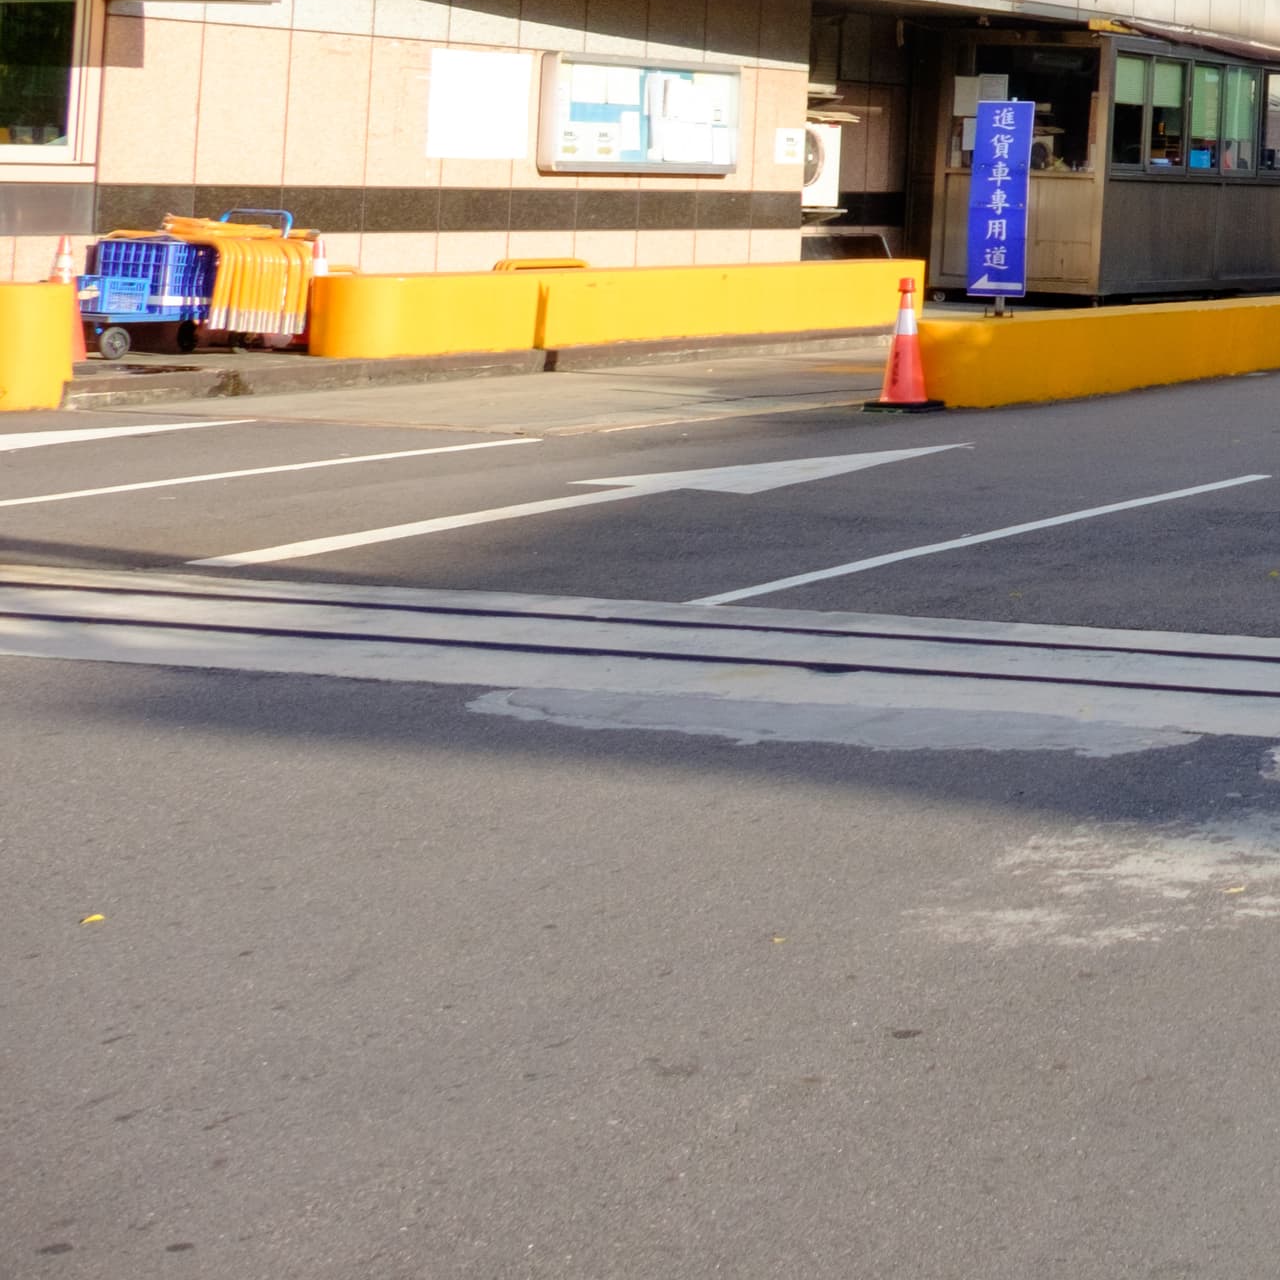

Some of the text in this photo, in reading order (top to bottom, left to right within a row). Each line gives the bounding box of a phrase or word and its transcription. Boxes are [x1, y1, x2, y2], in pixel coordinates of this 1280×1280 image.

[983, 107, 1017, 269] 進貨車專用道
